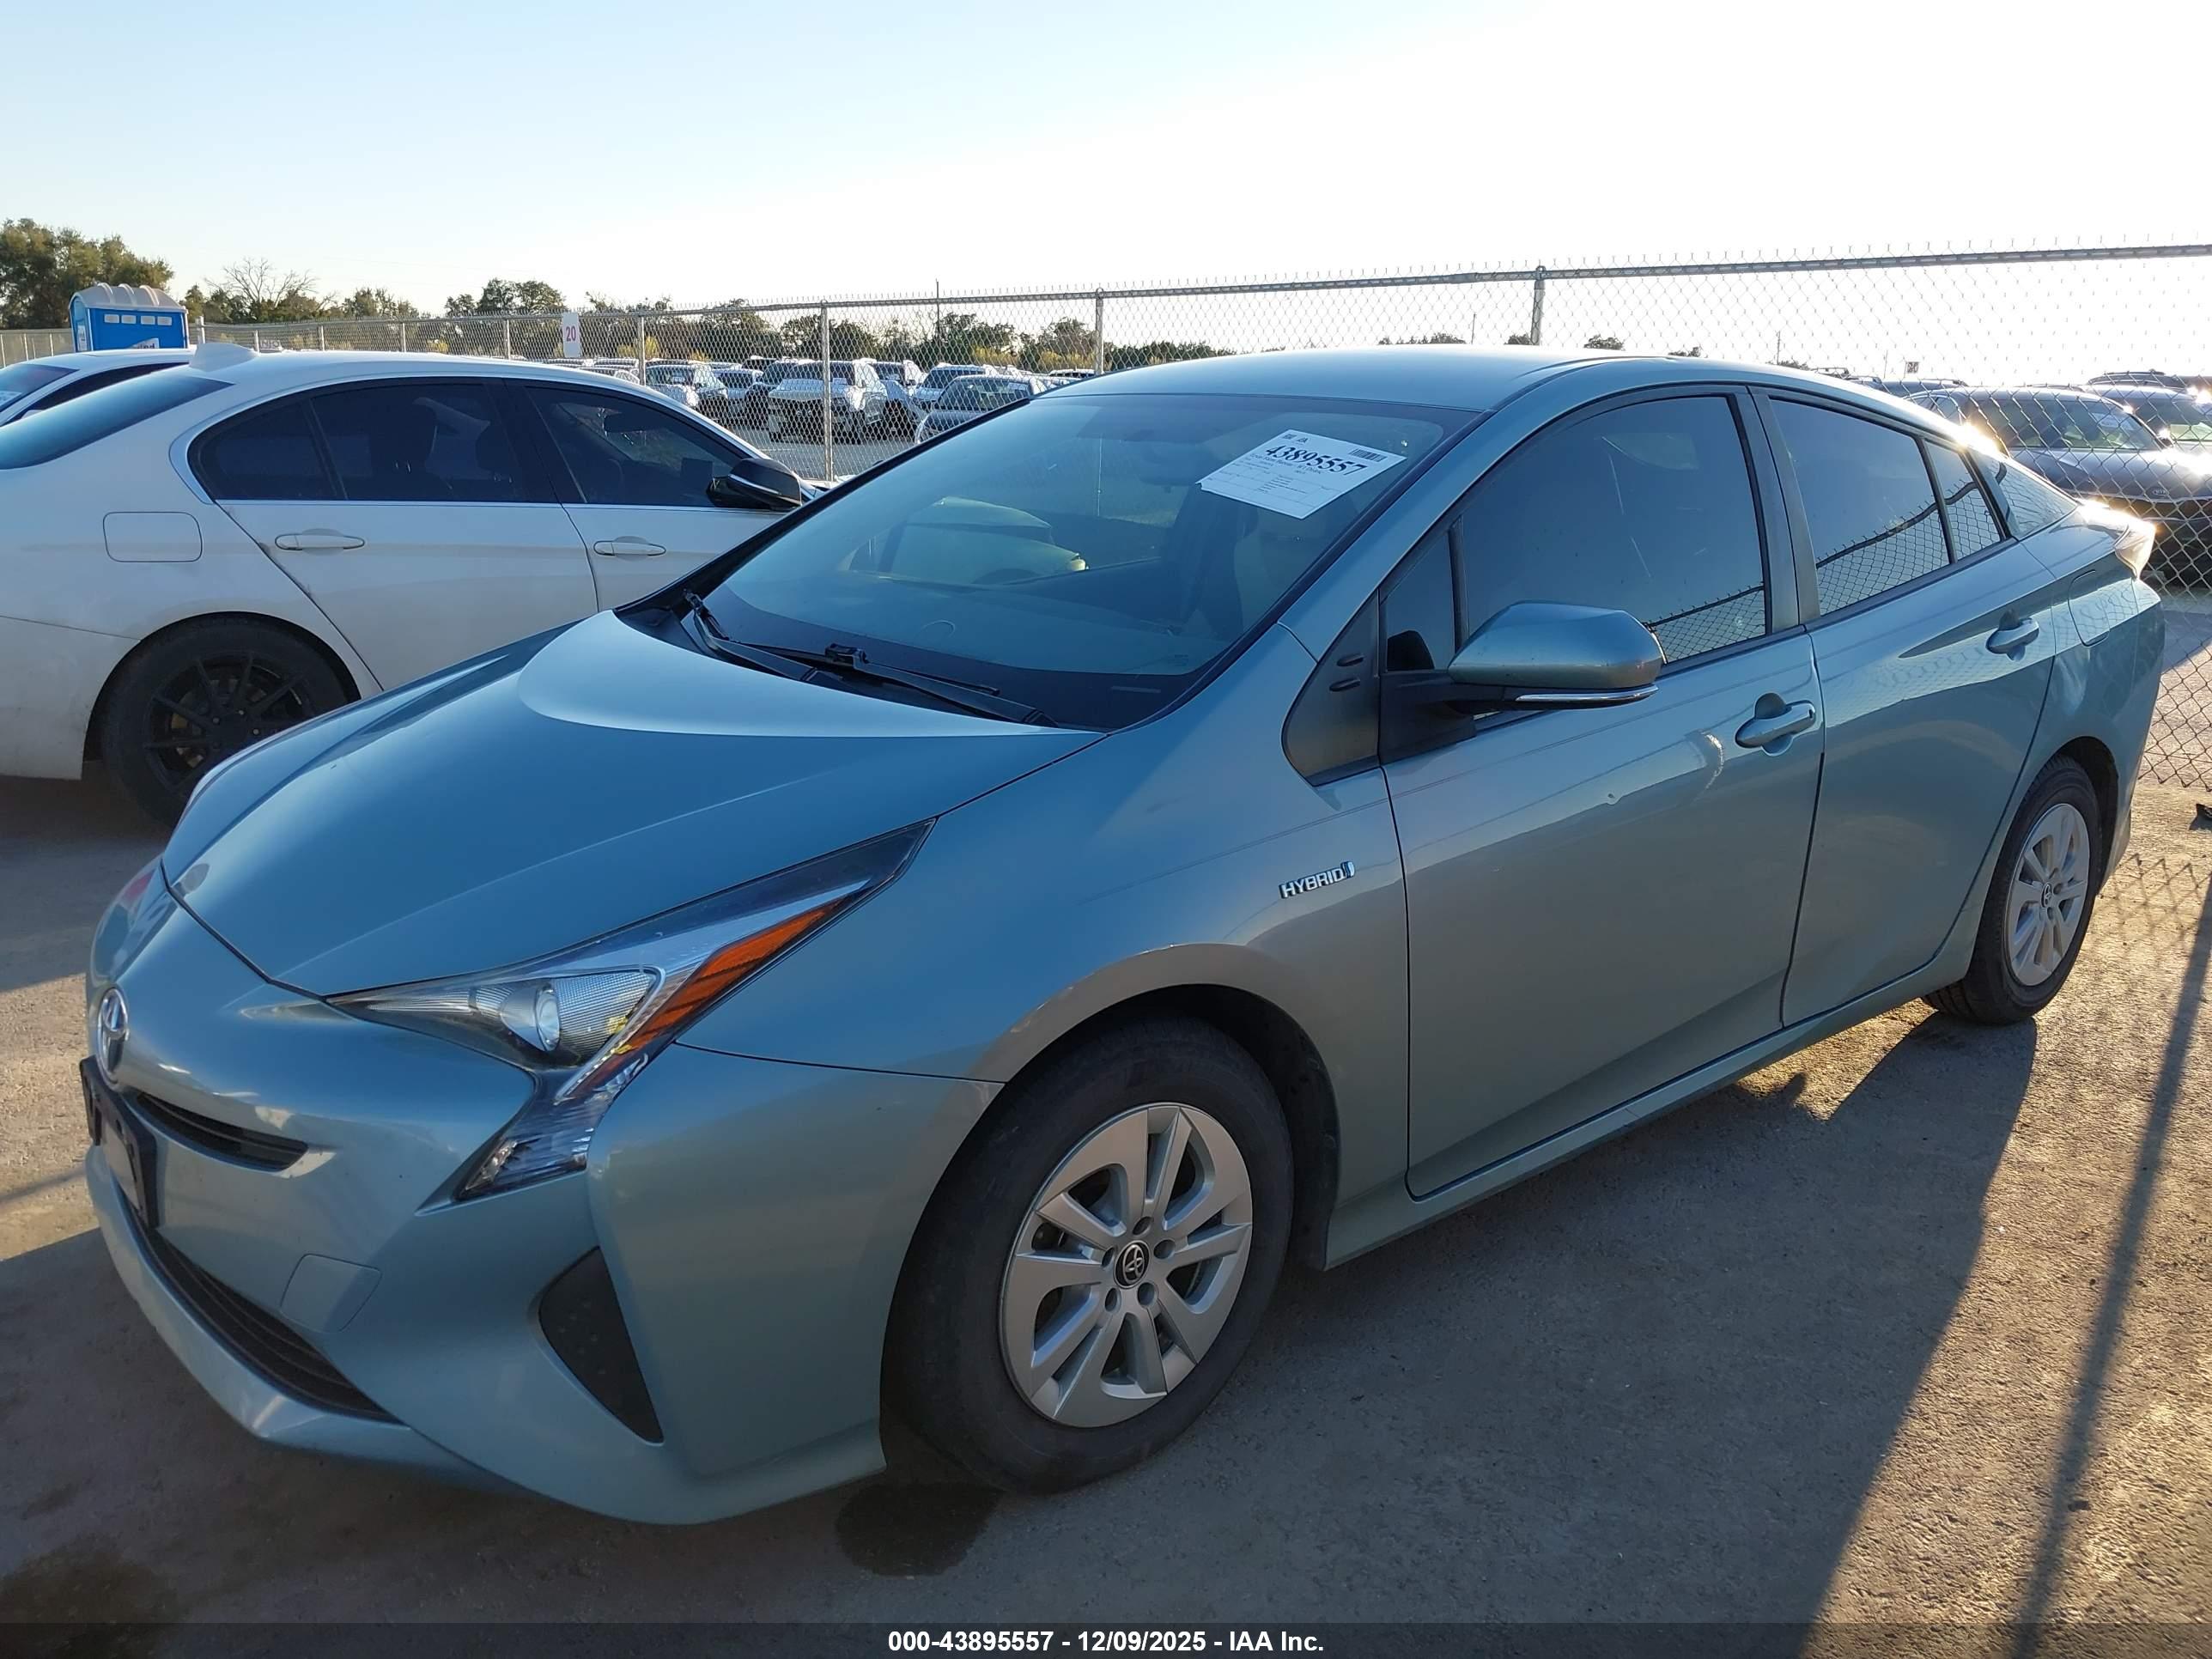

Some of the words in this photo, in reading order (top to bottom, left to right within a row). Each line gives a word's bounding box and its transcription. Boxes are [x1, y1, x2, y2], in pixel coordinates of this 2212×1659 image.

[566, 325, 576, 342] 20
[1266, 445, 1368, 476] 43895557
[1279, 866, 1346, 899] HYBRID
